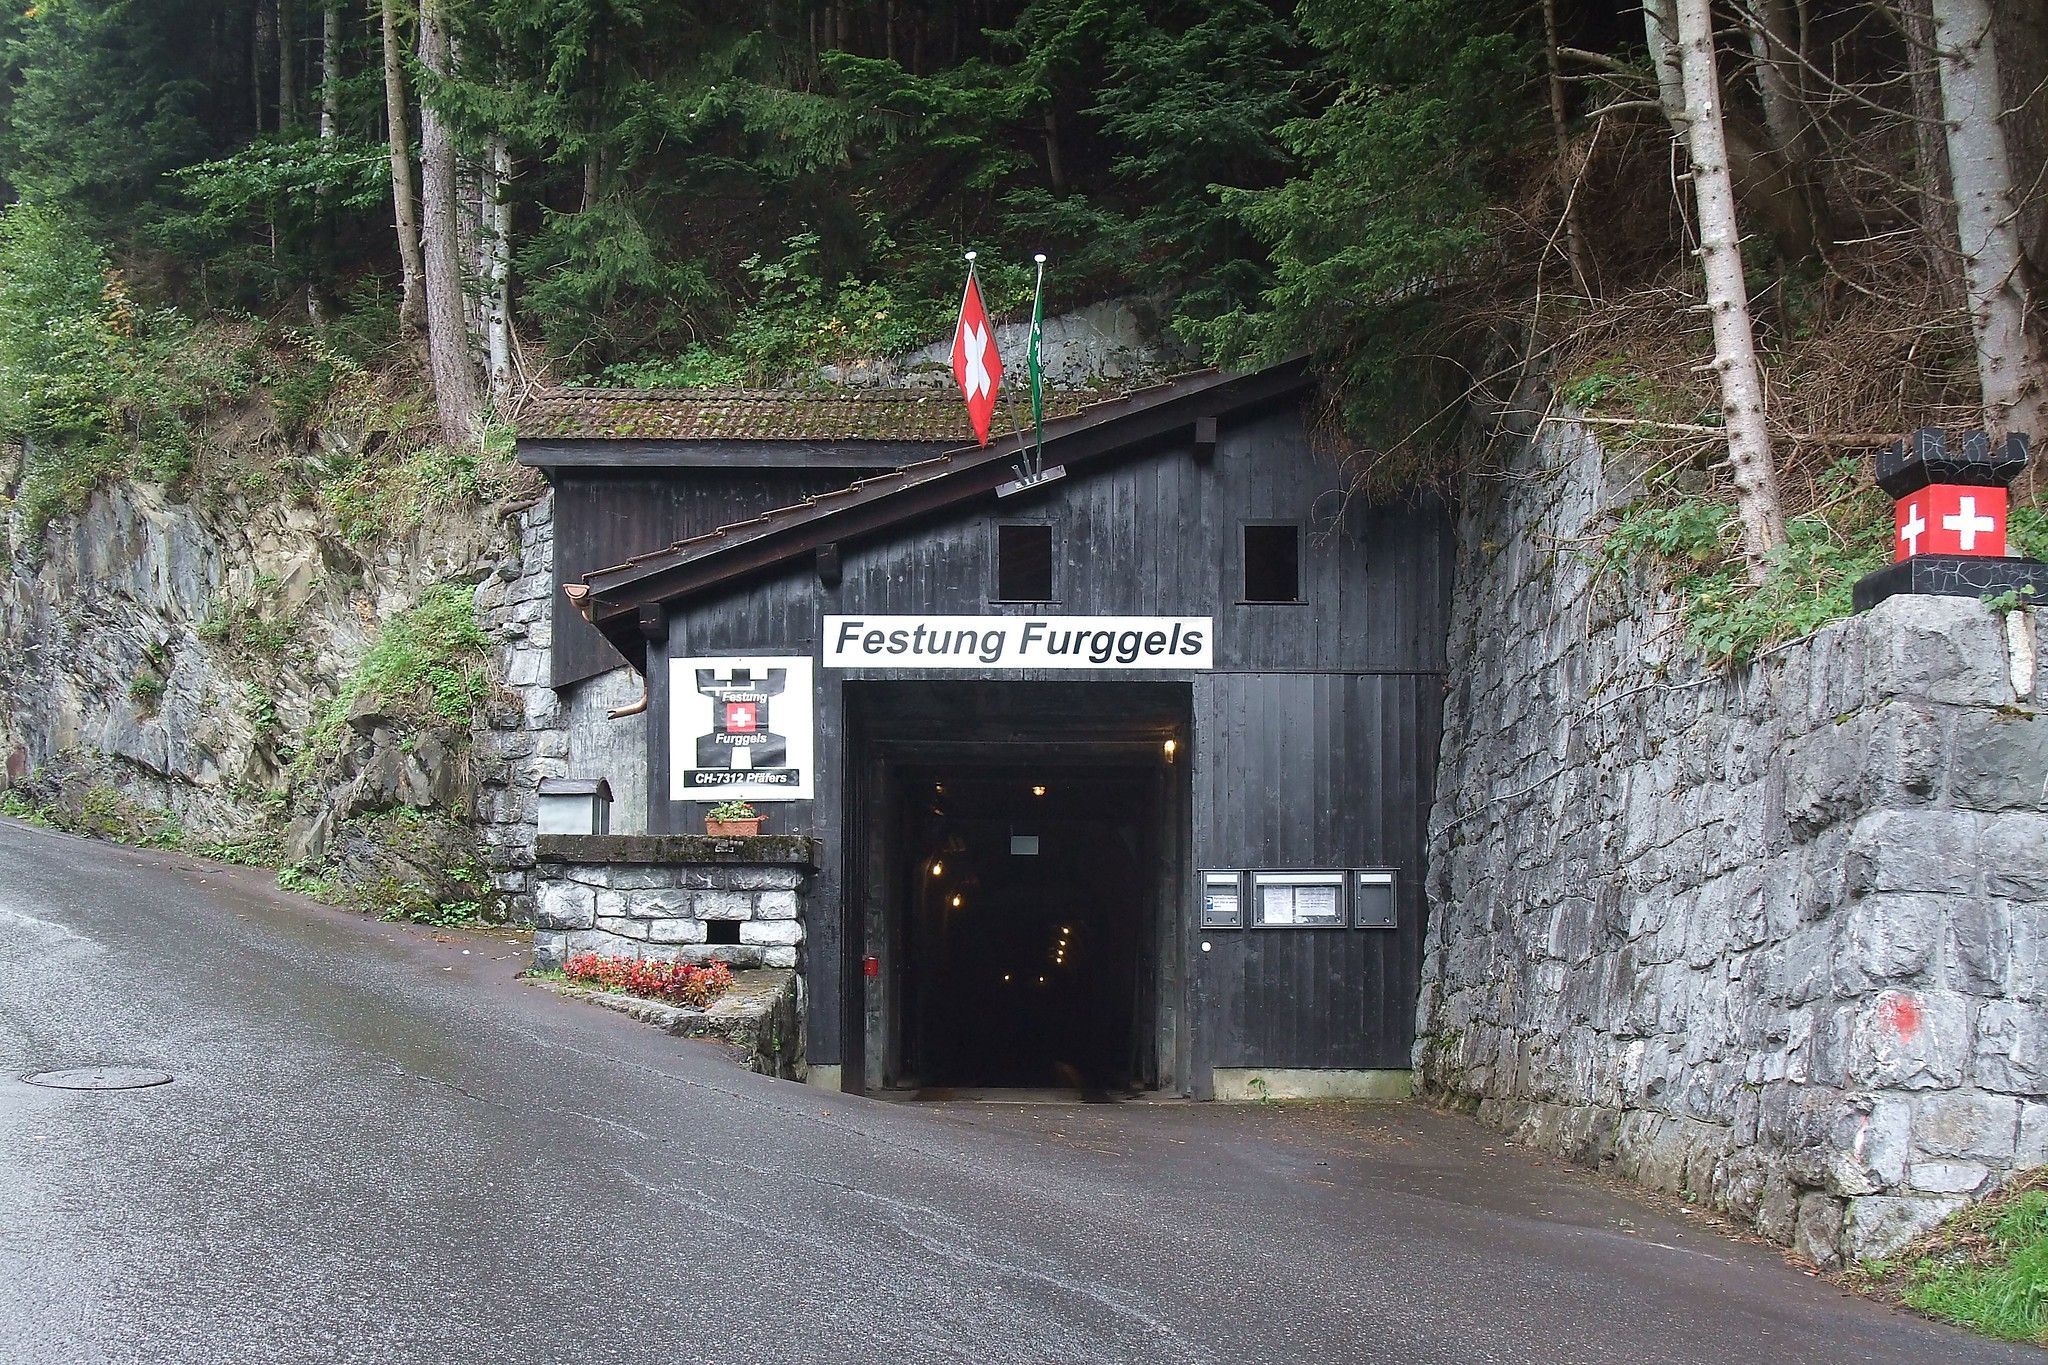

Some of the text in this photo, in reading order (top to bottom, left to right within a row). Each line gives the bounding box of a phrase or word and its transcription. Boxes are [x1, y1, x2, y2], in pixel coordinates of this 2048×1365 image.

[835, 621, 1204, 664] Festung Furggels
[722, 692, 767, 703] Festung
[715, 733, 767, 745] Furggels
[695, 773, 787, 784] CH-7312 Pfäfers
